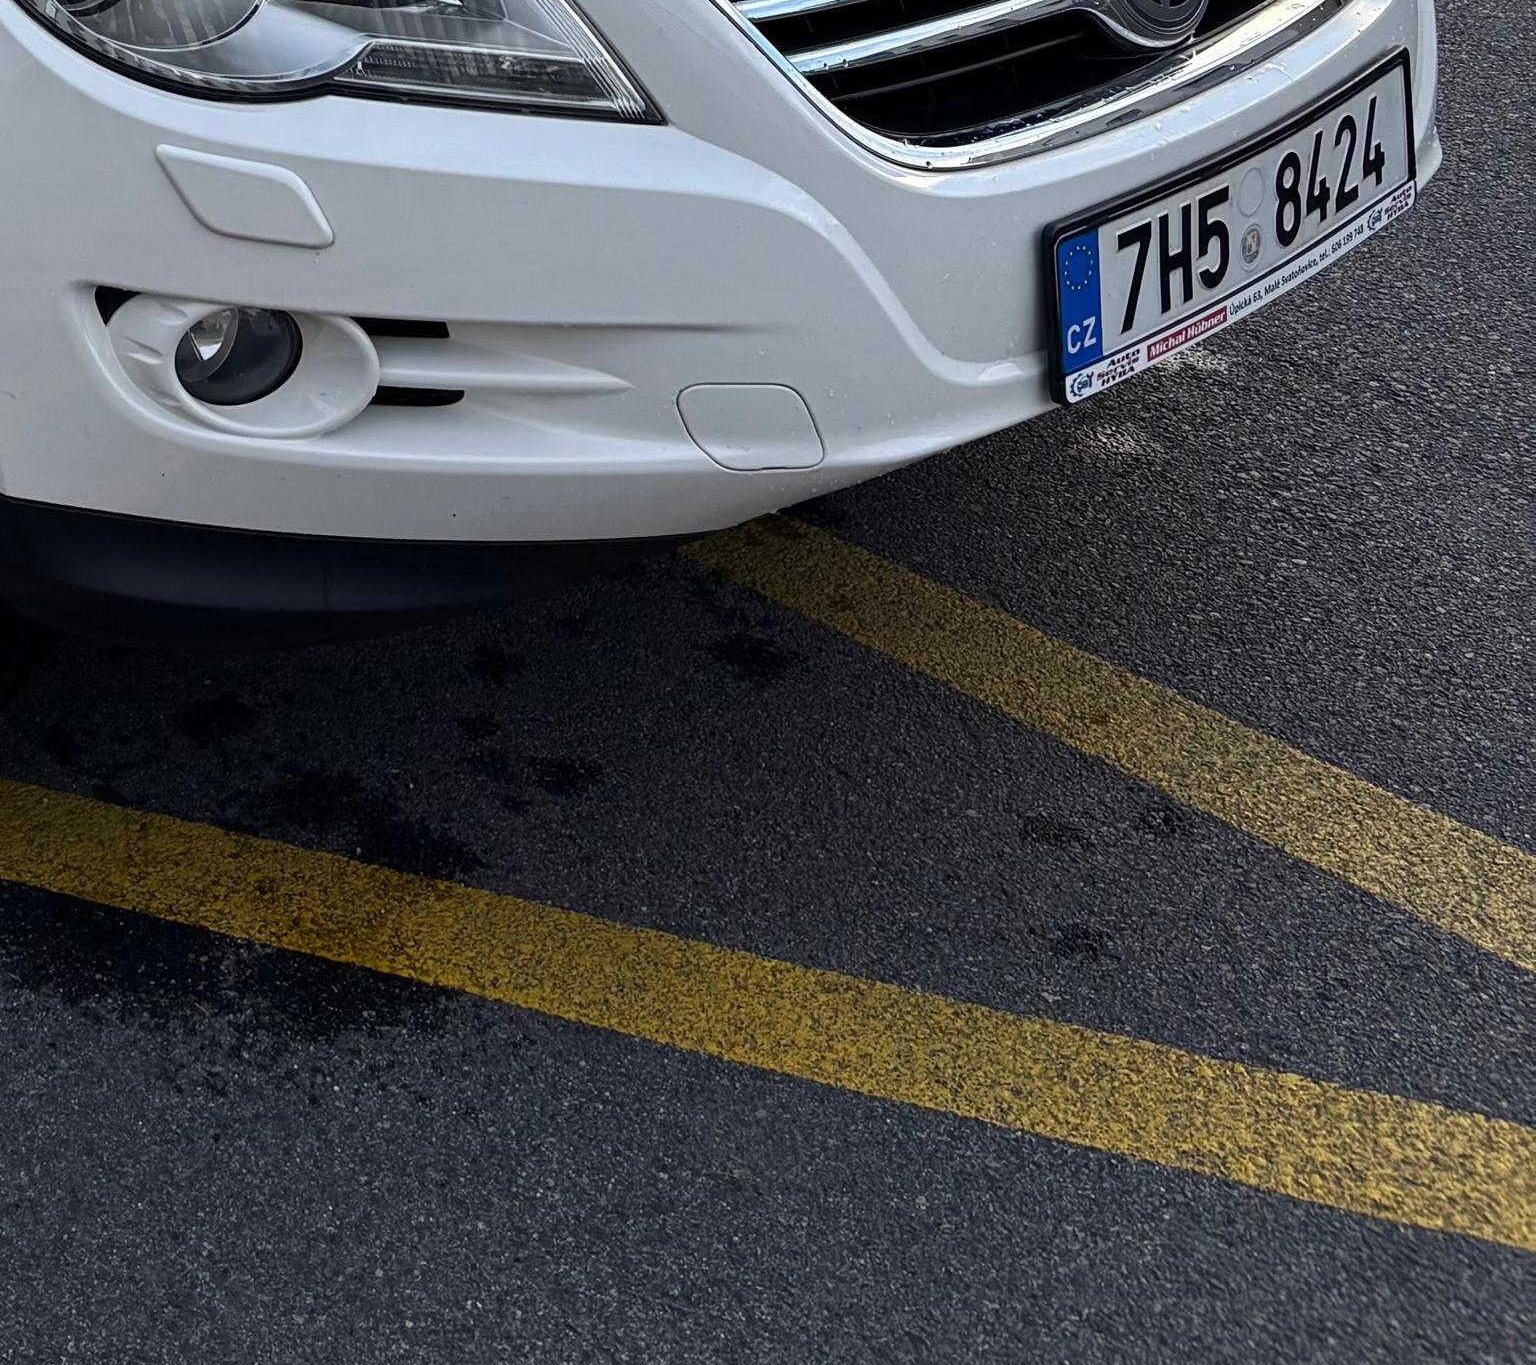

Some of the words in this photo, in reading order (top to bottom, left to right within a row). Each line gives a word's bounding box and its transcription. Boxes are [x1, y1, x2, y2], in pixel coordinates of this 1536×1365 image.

[1390, 185, 1413, 203] Auto
[1117, 184, 1231, 334] 7H5
[1275, 95, 1386, 248] 8424
[1066, 316, 1097, 355] CZ
[1149, 332, 1186, 359] Michal
[1106, 348, 1141, 368] Auto
